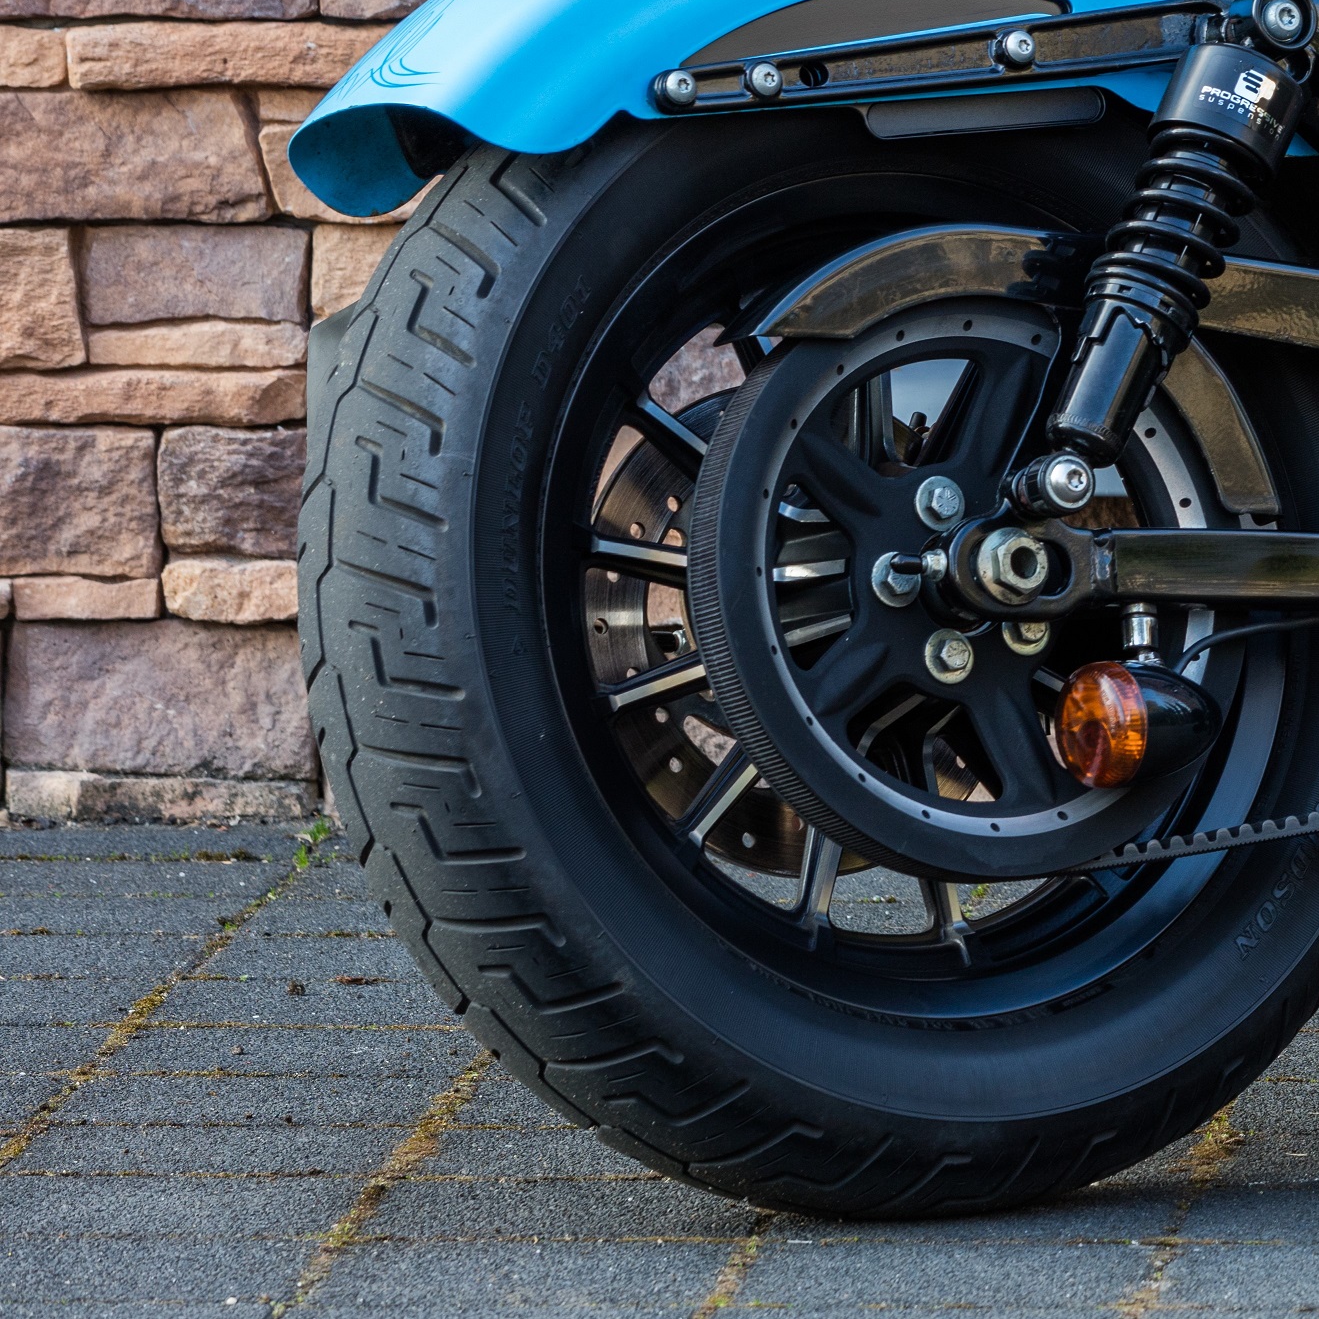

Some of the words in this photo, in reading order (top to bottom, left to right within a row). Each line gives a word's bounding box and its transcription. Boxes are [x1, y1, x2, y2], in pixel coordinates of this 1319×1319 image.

[1198, 93, 1281, 142] suspension
[1201, 84, 1285, 133] PROGRESSIVE
[499, 400, 533, 613] DUNLOP
[530, 273, 592, 391] D401
